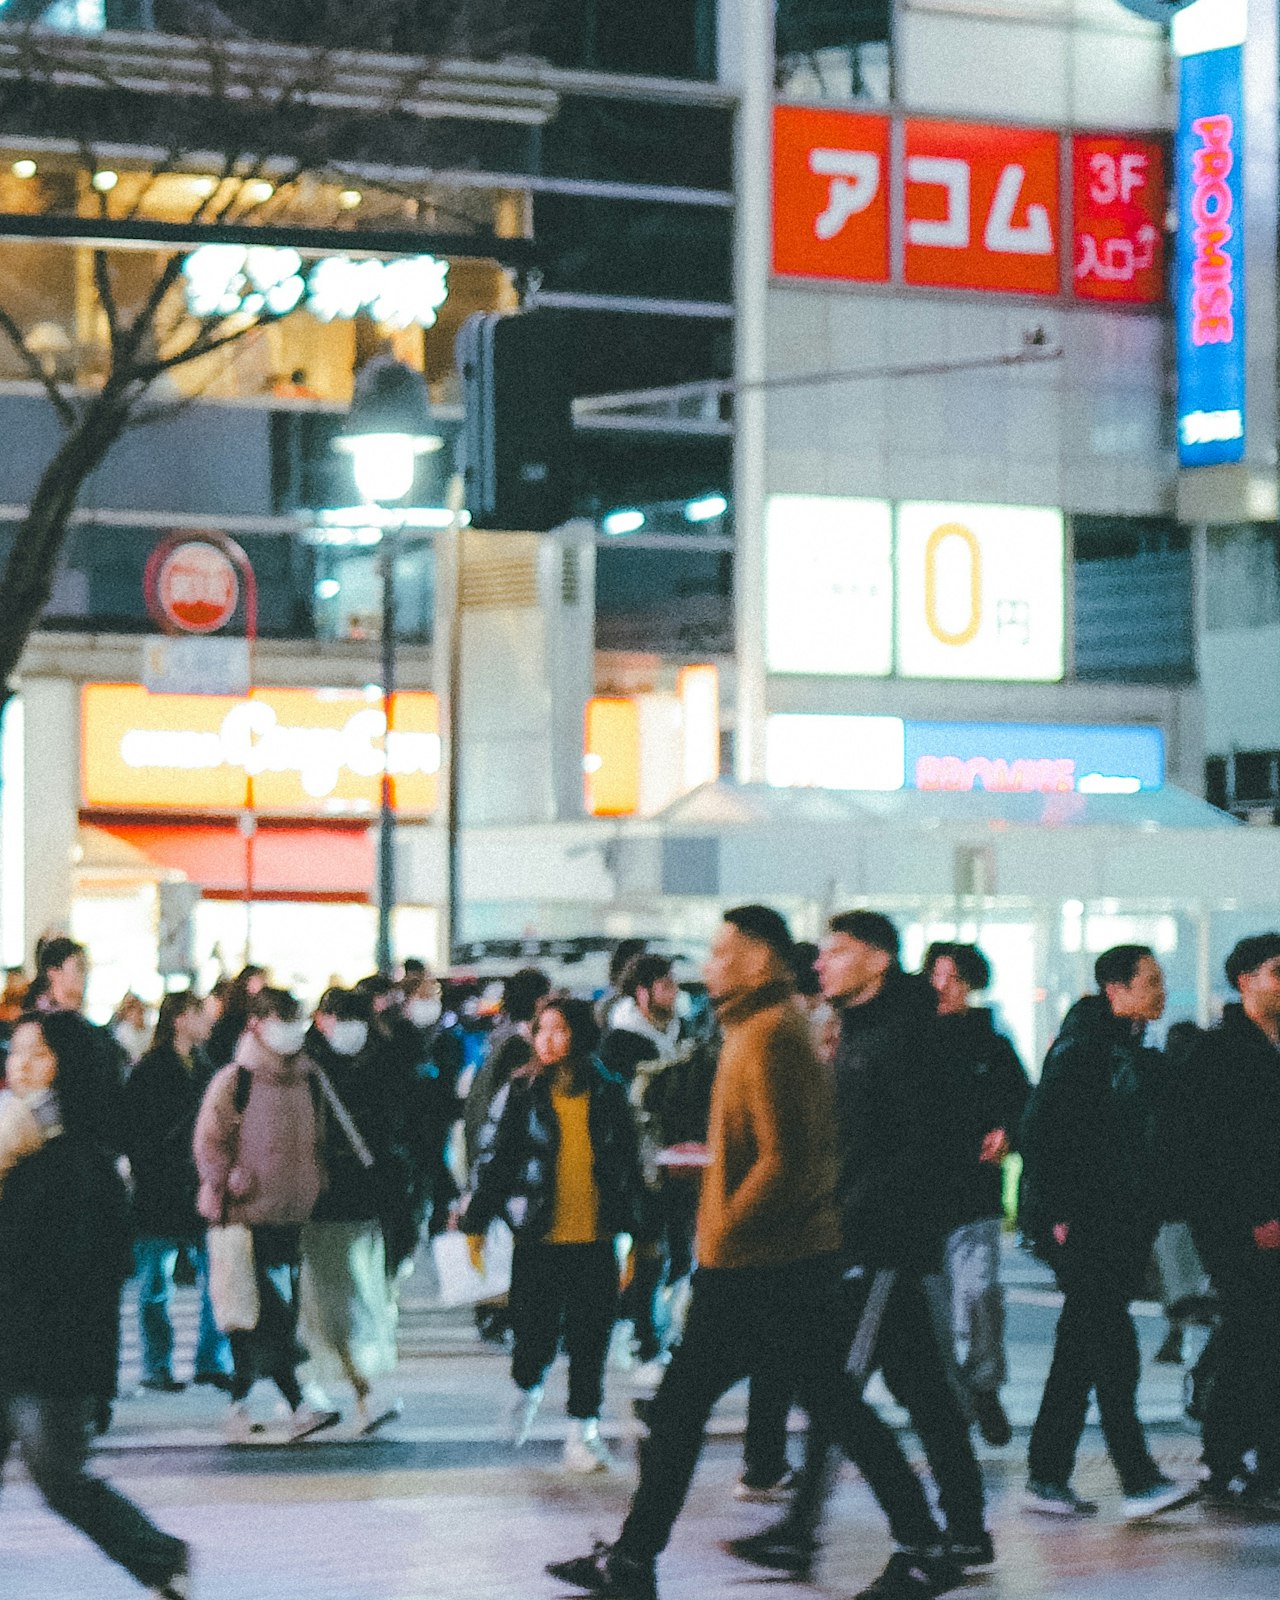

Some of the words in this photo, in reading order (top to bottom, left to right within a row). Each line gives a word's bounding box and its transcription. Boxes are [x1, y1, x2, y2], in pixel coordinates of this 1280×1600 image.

[808, 147, 1054, 255] アコム
[1088, 152, 1149, 206] 3F
[1190, 114, 1235, 346] PROMISE
